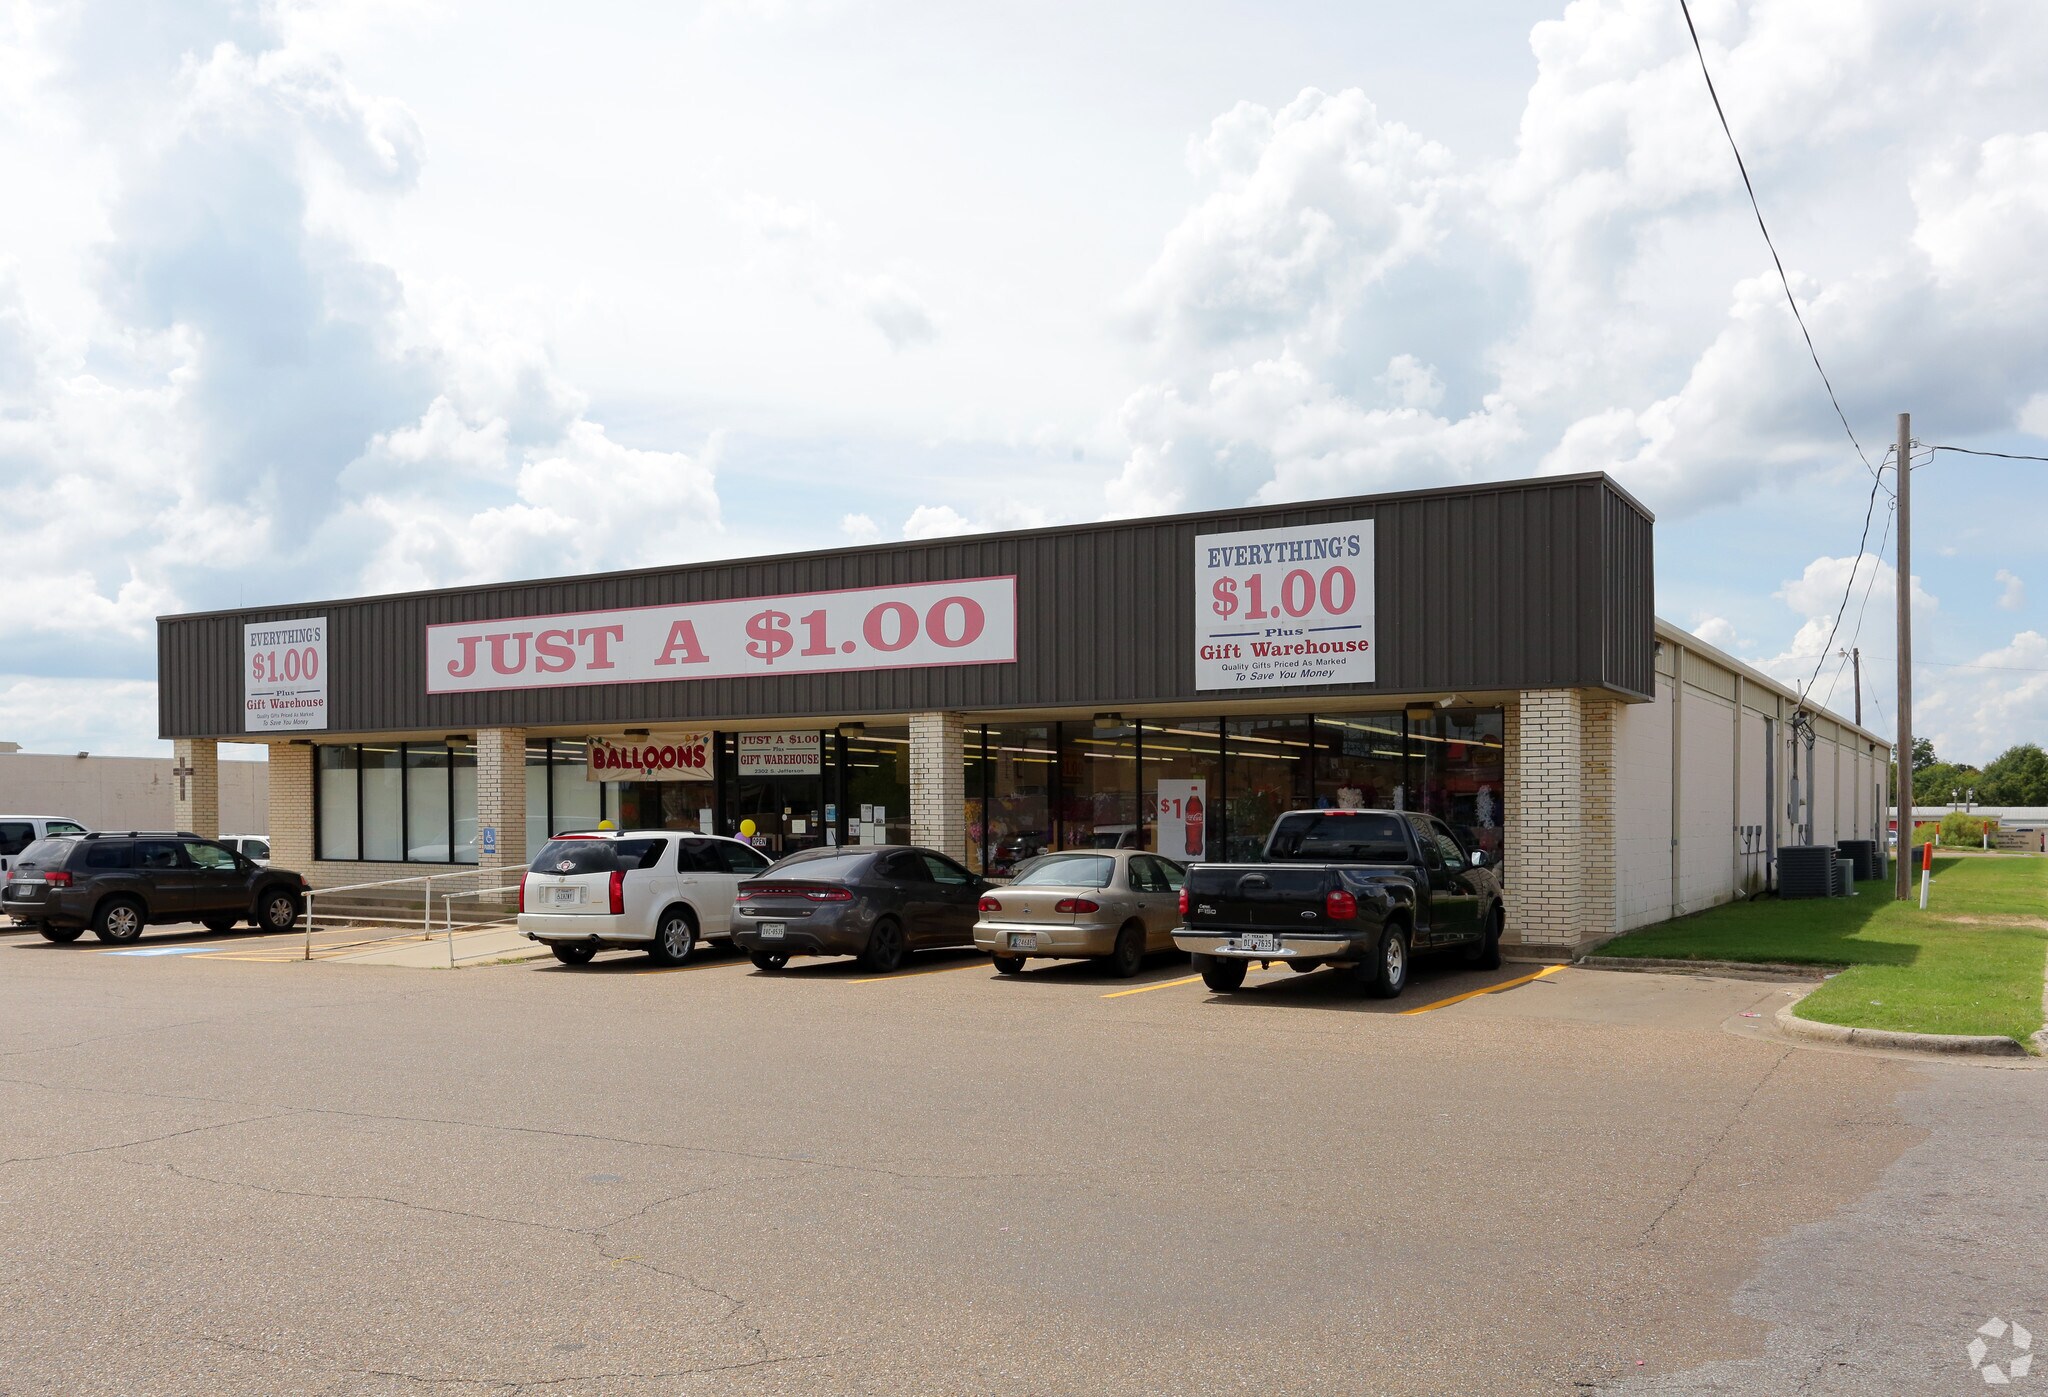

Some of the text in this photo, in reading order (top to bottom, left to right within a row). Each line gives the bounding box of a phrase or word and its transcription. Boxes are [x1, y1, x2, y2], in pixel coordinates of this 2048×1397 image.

[1208, 534, 1361, 568] EVERYTHING'S
[1212, 566, 1356, 621] $1.00
[250, 627, 321, 647] EVERYTHING'S
[447, 596, 985, 678] JUST A $1.00
[1264, 628, 1304, 638] Plus
[1200, 639, 1369, 660] Gift Warehouse
[252, 646, 319, 683] $1.00
[1221, 657, 1347, 671] Quality Gifts Priced As Marked
[1235, 668, 1335, 682] To Save You Money
[246, 698, 324, 710] Gift Warehouse
[741, 735, 819, 744] JUST A $1.00
[592, 744, 706, 769] BALLOONS
[741, 754, 819, 765] GIFT WAREHOUSE
[1161, 798, 1181, 819] $1
